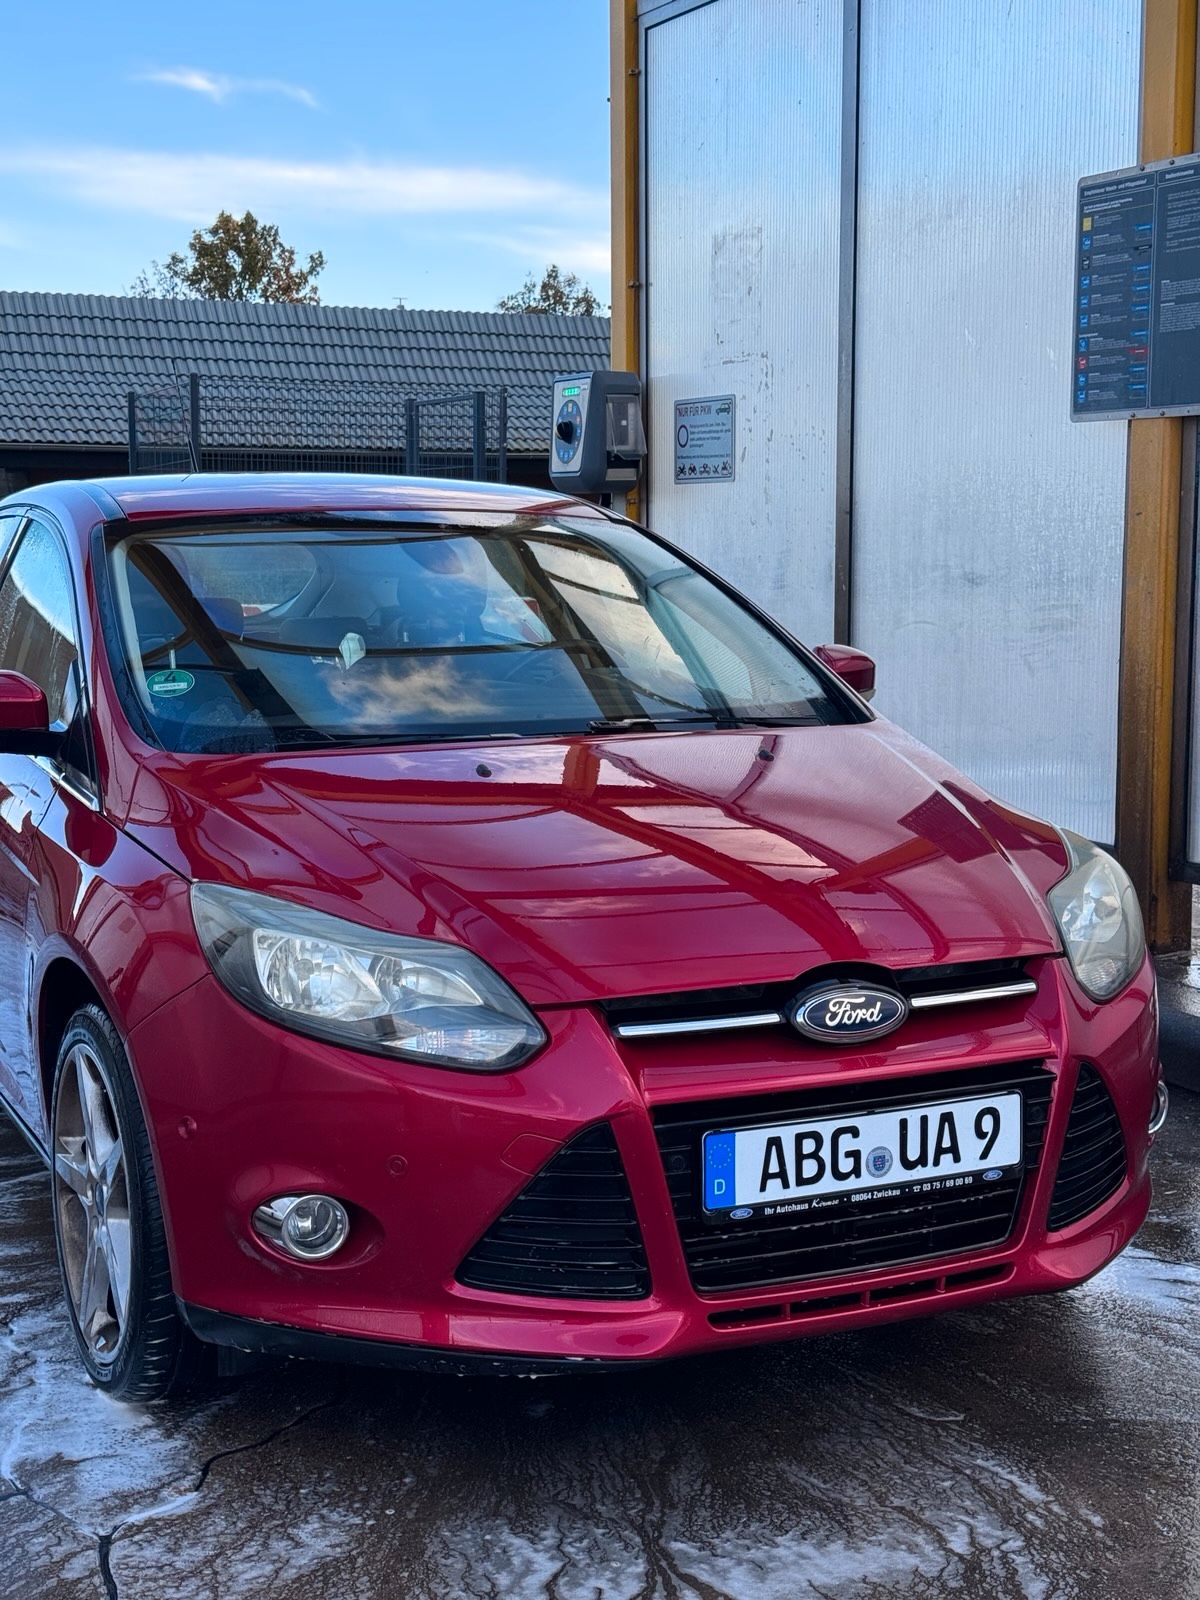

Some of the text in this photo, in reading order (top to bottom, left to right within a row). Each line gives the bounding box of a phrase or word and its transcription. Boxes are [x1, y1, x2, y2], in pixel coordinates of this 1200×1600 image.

[825, 996, 883, 1027] Ford
[759, 1106, 1001, 1192] ABG UA 9
[714, 1178, 726, 1195] D
[764, 1207, 774, 1216] Ihr
[776, 1203, 809, 1214] Autohaus
[851, 1193, 872, 1202] 08064
[872, 1189, 901, 1199] Zwickau
[922, 1184, 931, 1192] 03
[932, 1182, 941, 1190] 75
